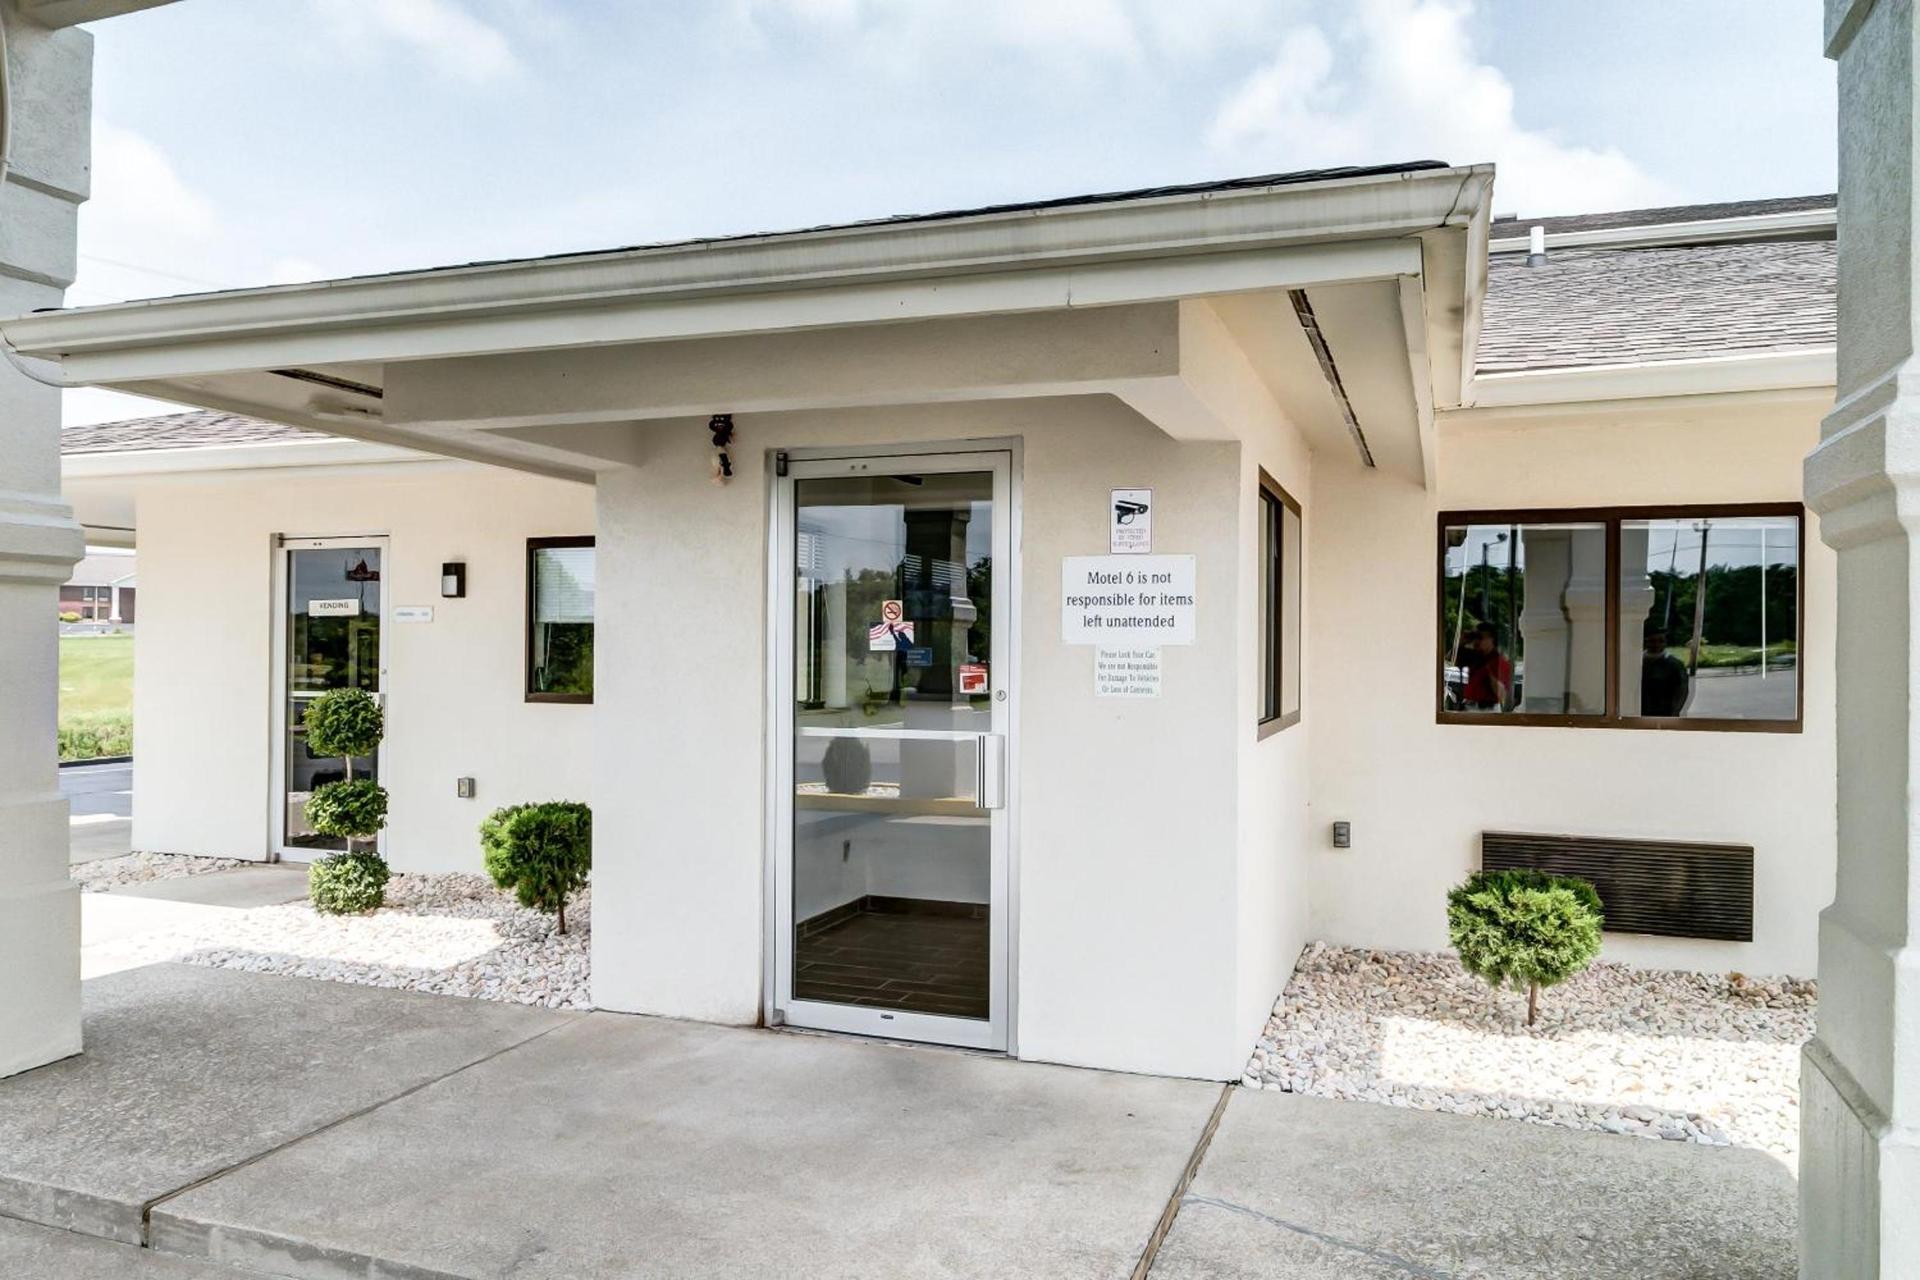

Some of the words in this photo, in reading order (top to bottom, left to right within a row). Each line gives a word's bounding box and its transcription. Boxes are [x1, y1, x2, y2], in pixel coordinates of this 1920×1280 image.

[1087, 571, 1122, 585] Motel
[1126, 571, 1134, 584] 6
[1138, 571, 1148, 584] is
[1152, 572, 1172, 584] not
[1066, 593, 1135, 609] responsible
[1139, 593, 1157, 606] for
[1160, 593, 1194, 606] items
[1083, 615, 1102, 628] left
[1106, 615, 1175, 628] unattended
[1119, 650, 1131, 659] Lock
[1132, 650, 1144, 659] Your
[1098, 661, 1107, 670] We
[1128, 662, 1158, 672] Responsible
[1098, 673, 1107, 682] For
[1108, 673, 1128, 684] Damage
[1130, 673, 1137, 682] To
[1137, 674, 1160, 682] Vehicles
